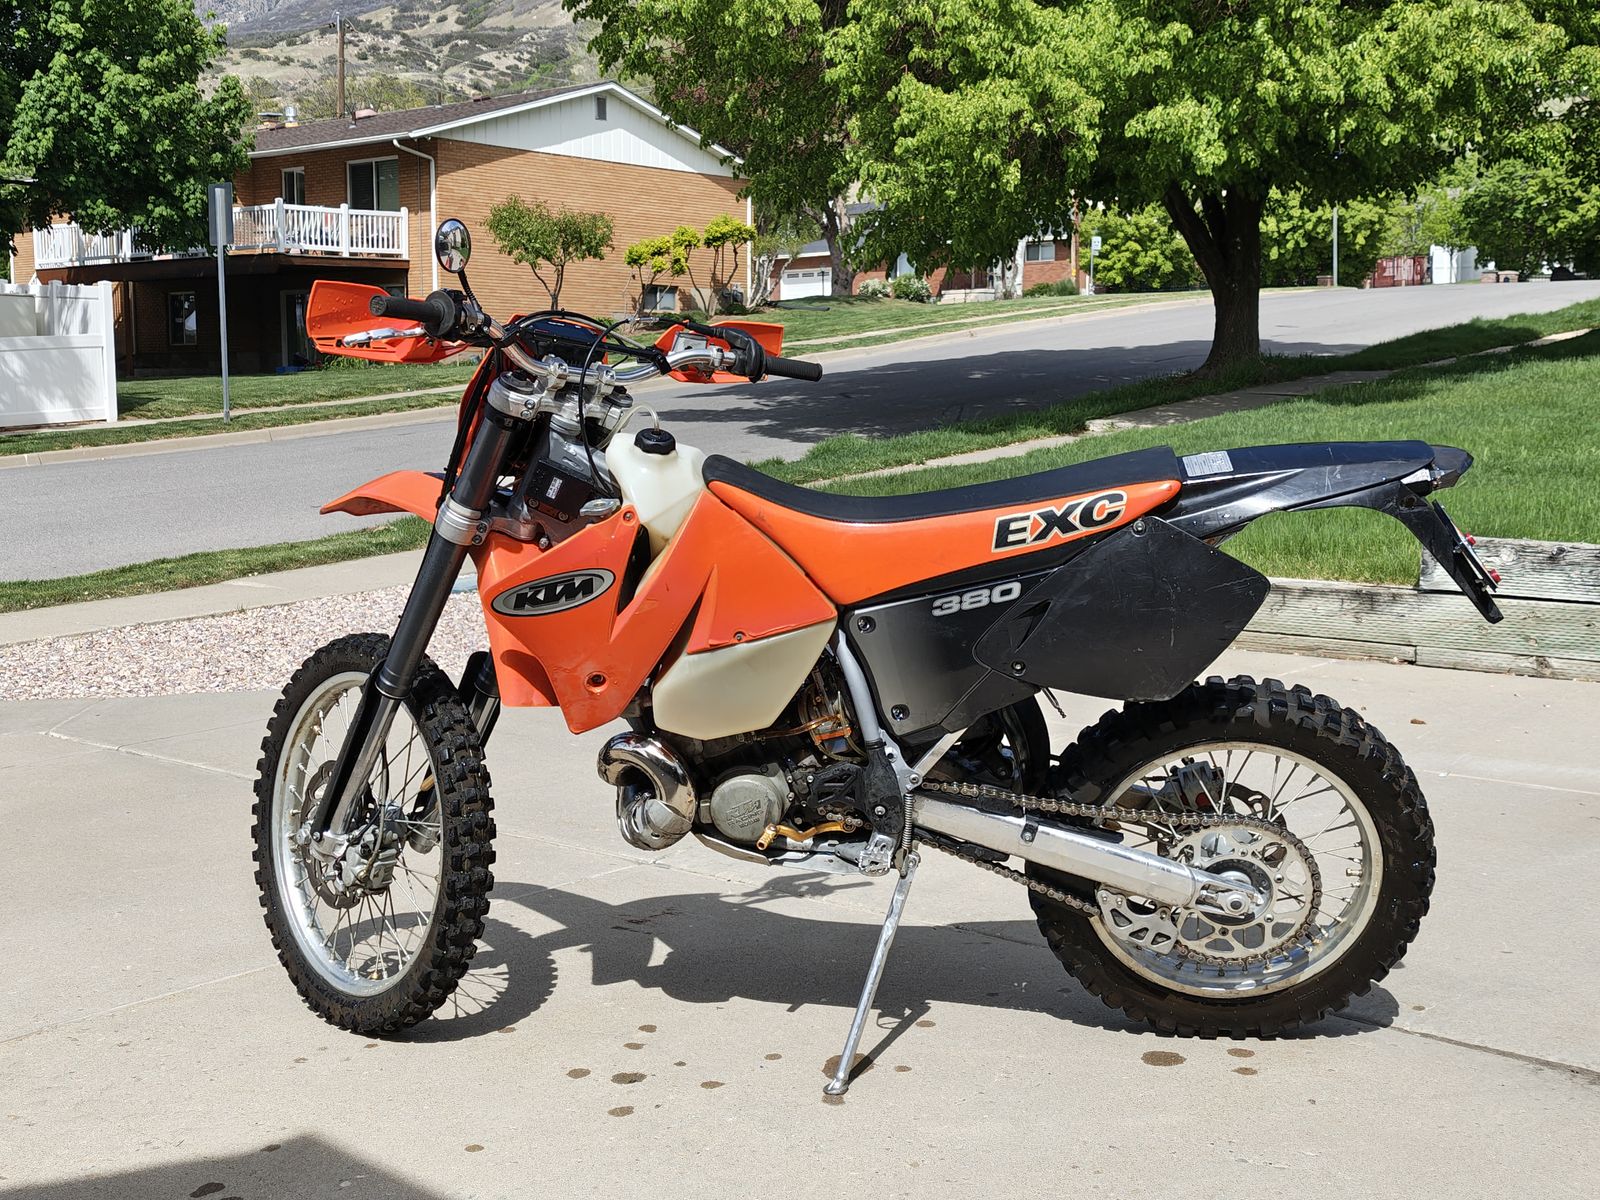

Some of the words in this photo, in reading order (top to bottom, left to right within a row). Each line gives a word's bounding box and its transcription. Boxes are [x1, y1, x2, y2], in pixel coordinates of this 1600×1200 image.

[991, 490, 1127, 553] EXC
[513, 577, 594, 611] KTM
[931, 582, 1022, 617] 380
